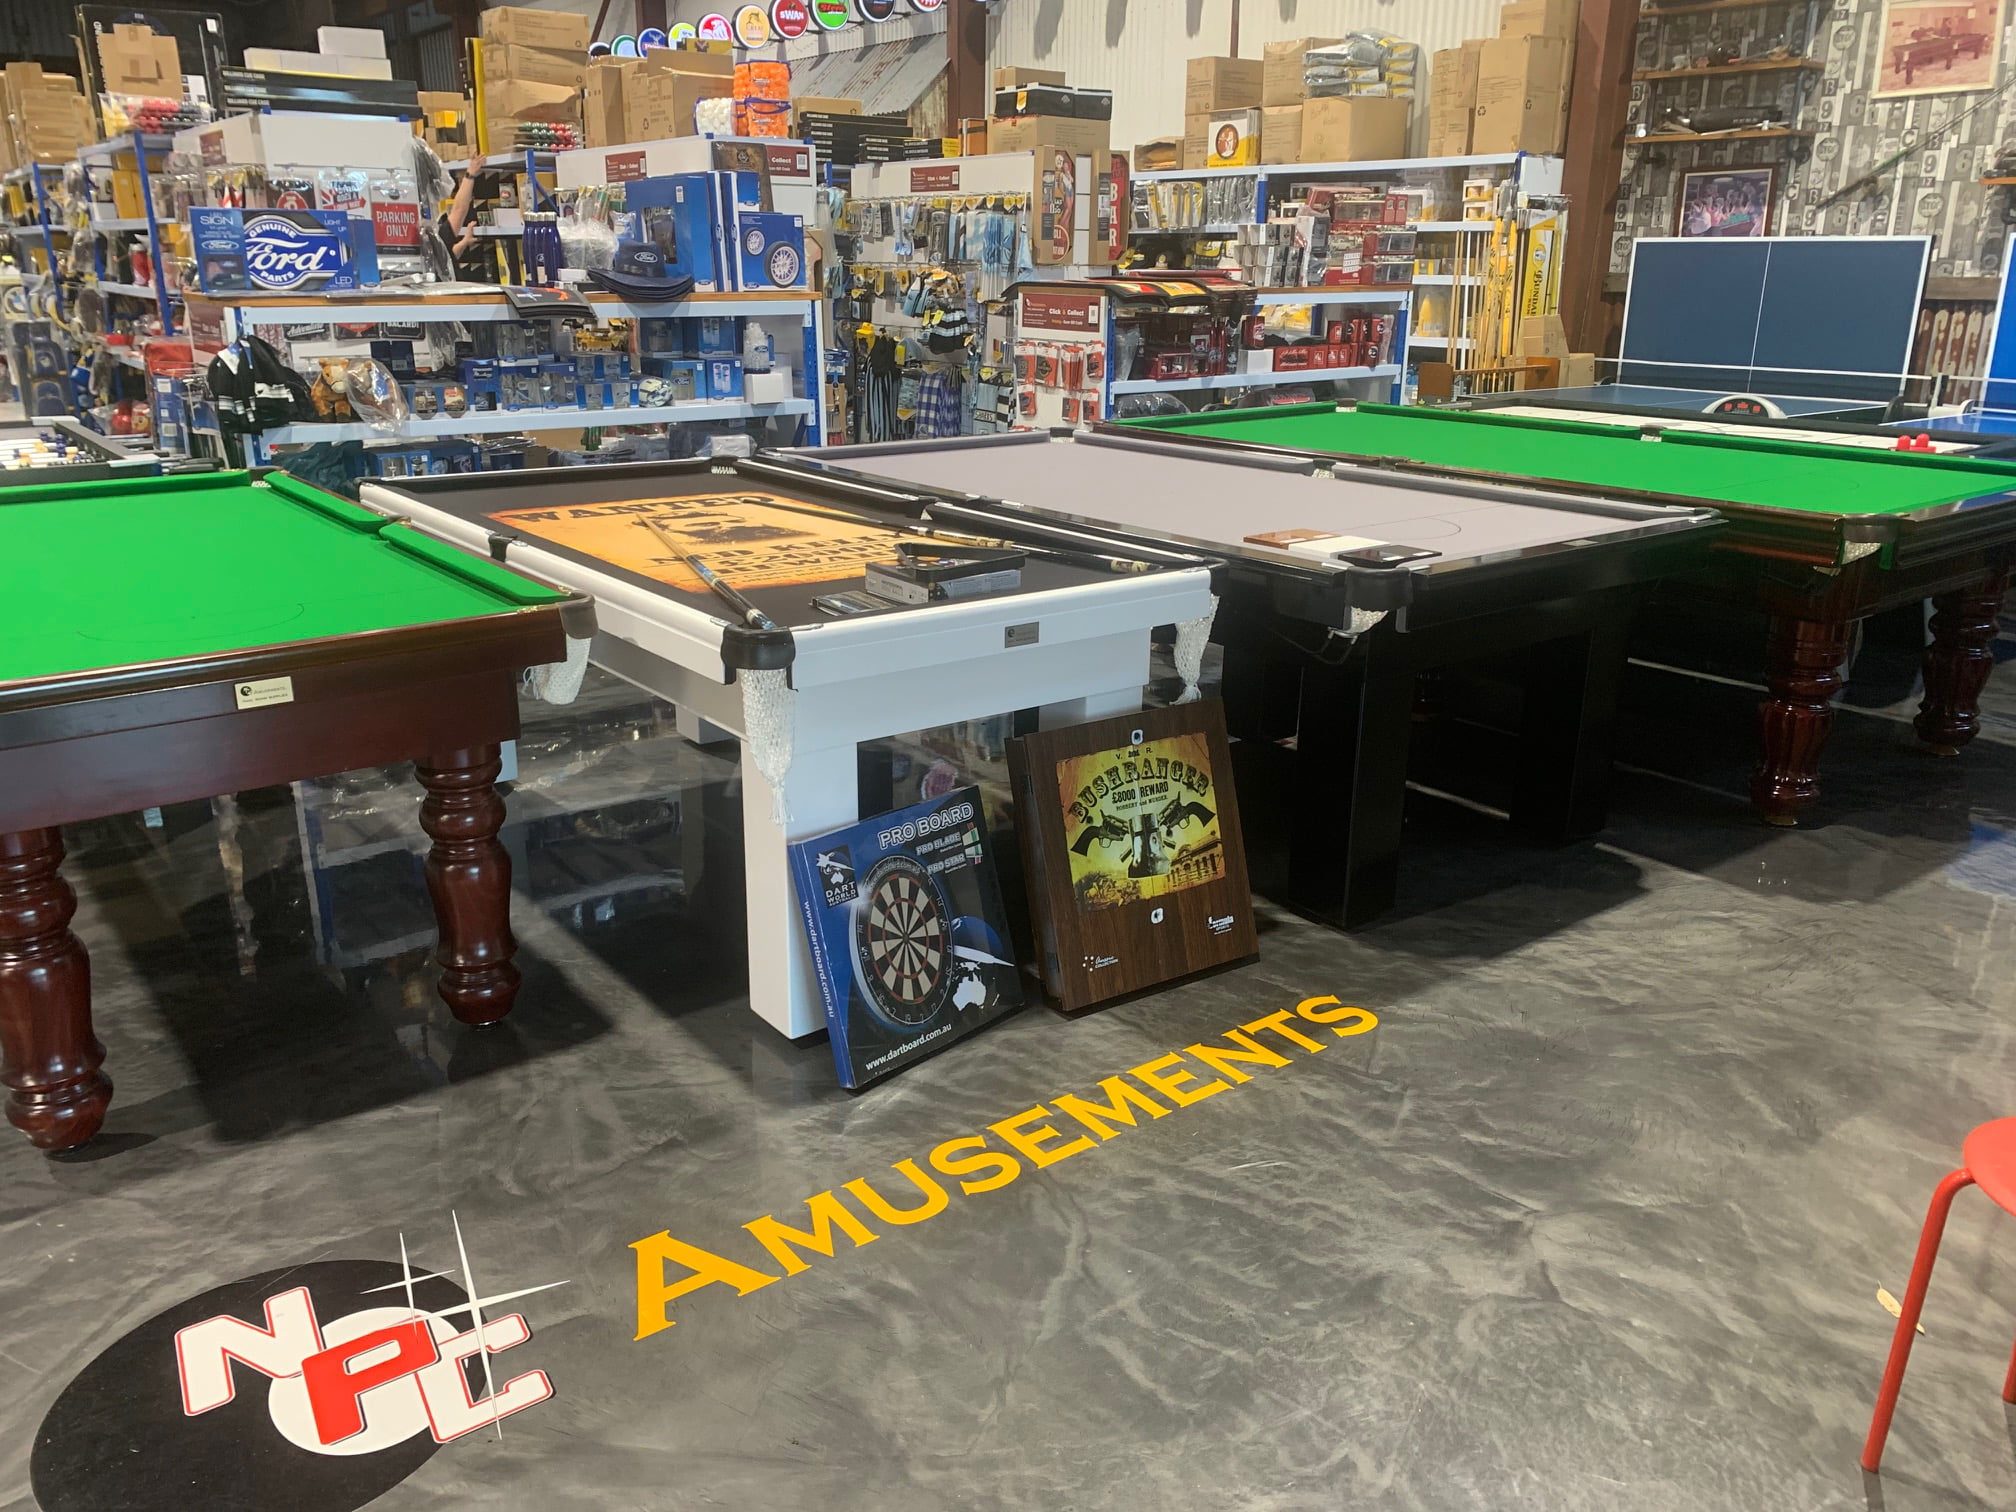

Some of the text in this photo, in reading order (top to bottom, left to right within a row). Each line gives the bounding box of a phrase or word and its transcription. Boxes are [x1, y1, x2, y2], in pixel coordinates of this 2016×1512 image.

[779, 9, 804, 20] SWAN
[200, 215, 234, 225] SIGN
[376, 210, 416, 225] PARKING
[249, 223, 297, 239] GENUINE
[386, 224, 409, 237] ONLY
[246, 242, 328, 271] Ford
[260, 271, 295, 282] PARTS
[507, 494, 774, 523] WANTED
[767, 530, 905, 551] KELLY
[713, 550, 897, 574] REWAR
[1069, 757, 1210, 823] BUSHRANGER
[1112, 781, 1169, 804] £8000 REWARD
[878, 802, 974, 850] PRO BOARD
[916, 842, 934, 856] PRO
[933, 831, 961, 850] BLADE
[926, 860, 944, 875] PRO
[944, 853, 965, 868] STAR
[825, 881, 855, 898] DART
[827, 889, 857, 904] WORLD
[804, 901, 834, 1018] www.dartboard.com.au
[865, 1023, 952, 1071] www.dartboard.com.au
[627, 994, 1380, 1342] AMUSEMENTS
[174, 1286, 555, 1445] NPC
